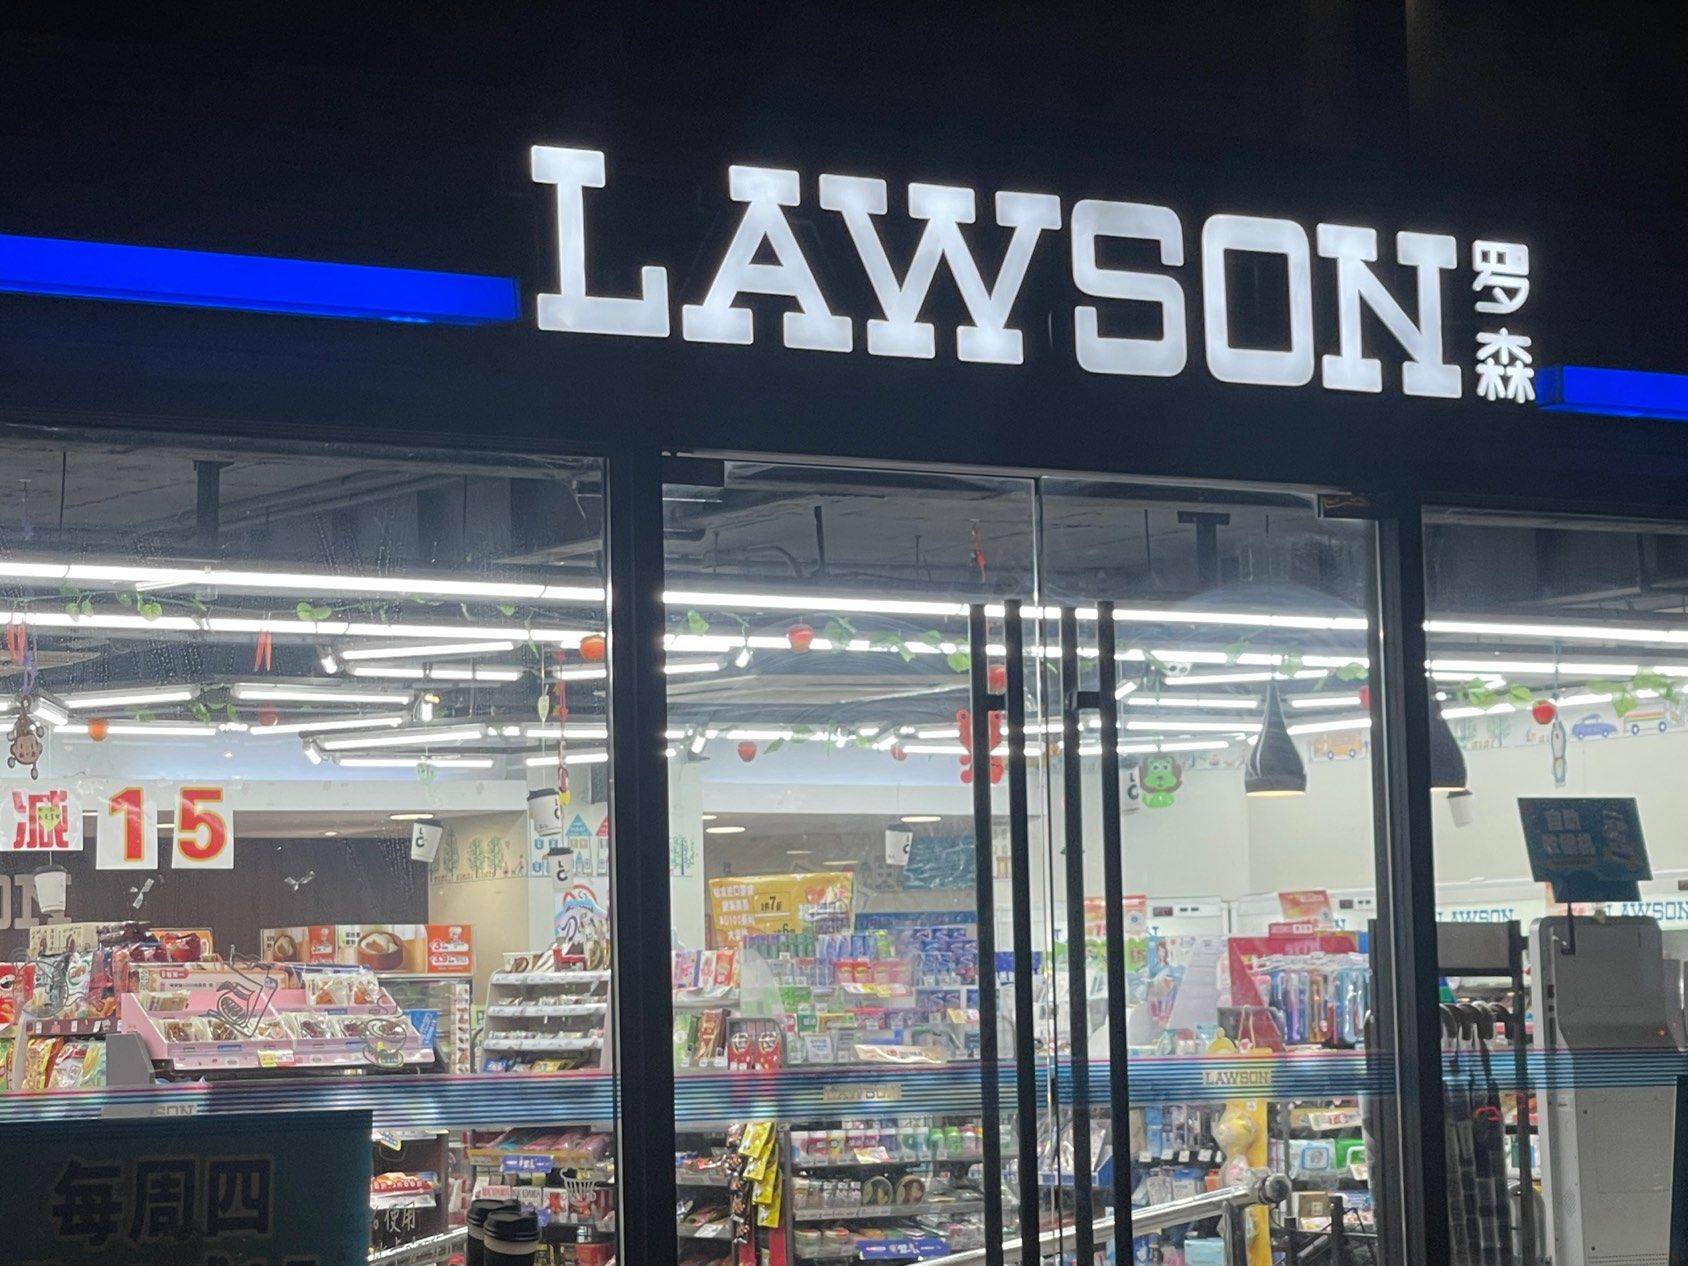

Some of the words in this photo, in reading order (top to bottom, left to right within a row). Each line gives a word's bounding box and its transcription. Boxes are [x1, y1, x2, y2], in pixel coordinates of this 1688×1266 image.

[530, 144, 1463, 399] LAWSON
[1471, 239, 1535, 403] 罗森
[1204, 1070, 1271, 1086] LAWSON
[52, 1154, 274, 1248] 每周四
